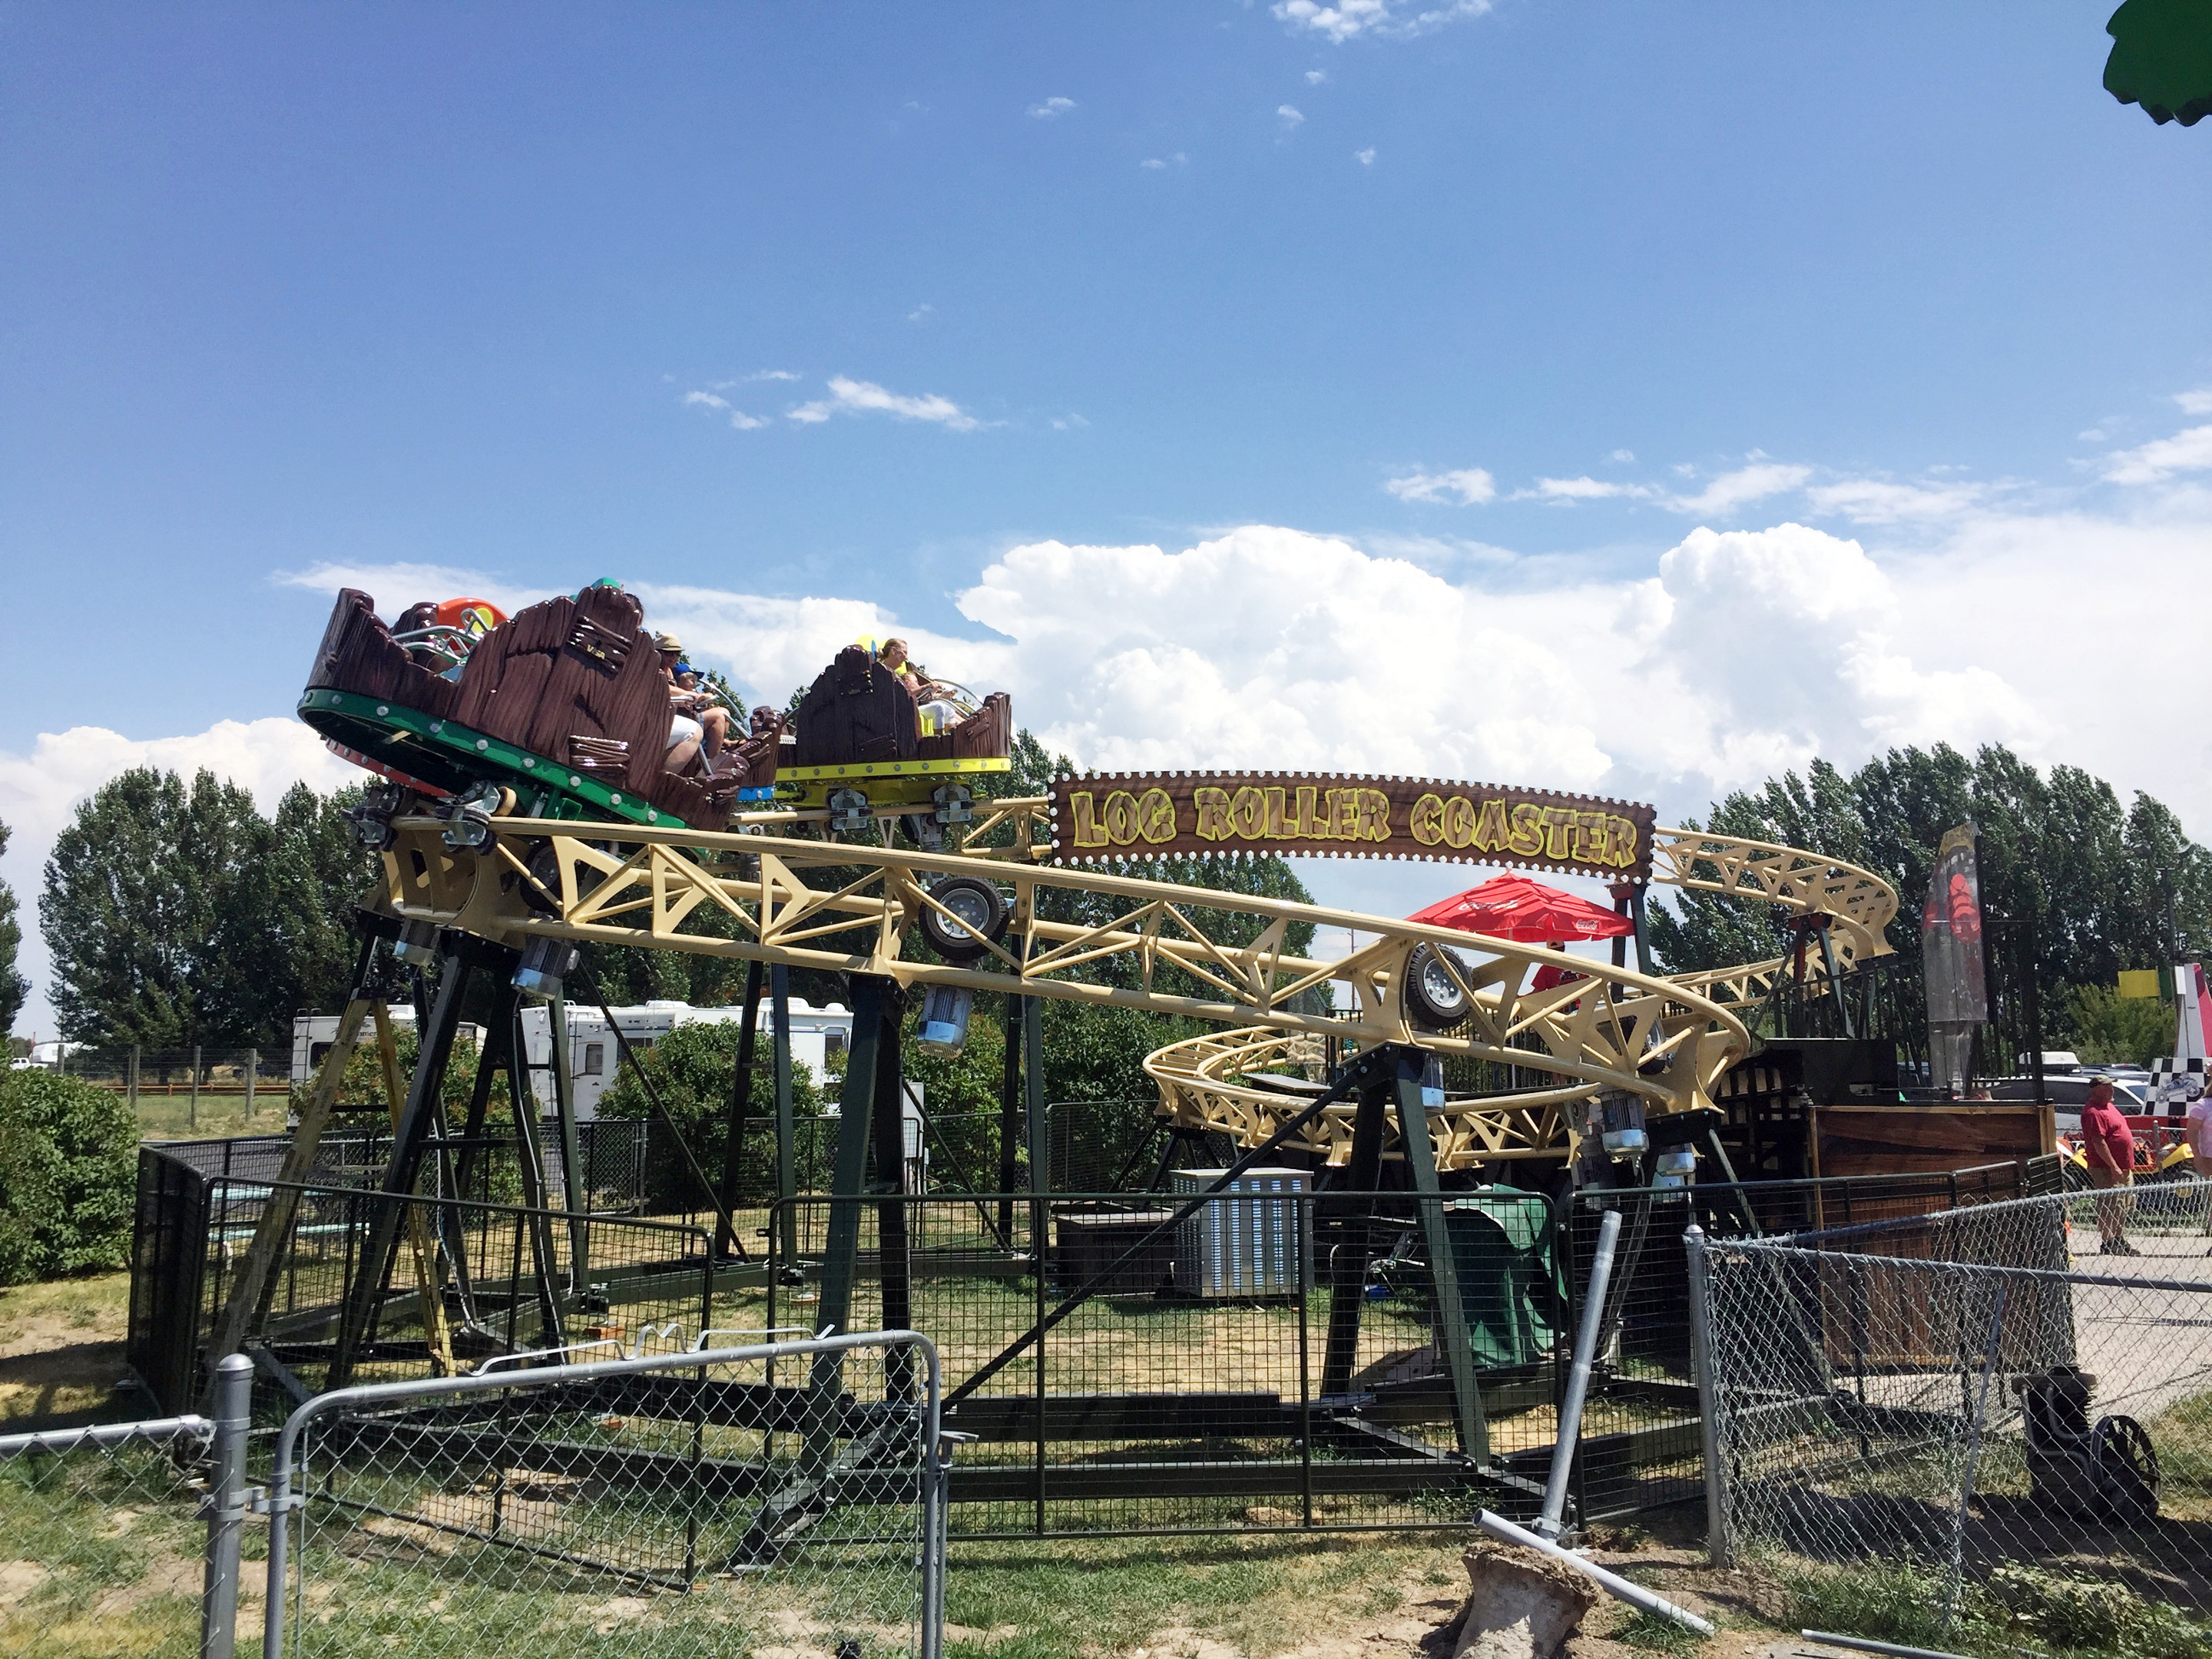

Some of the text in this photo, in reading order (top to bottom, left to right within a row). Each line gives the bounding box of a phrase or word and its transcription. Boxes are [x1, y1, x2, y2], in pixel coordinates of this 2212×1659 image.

[1069, 786, 1637, 868] LOG ROLLER COASTER
